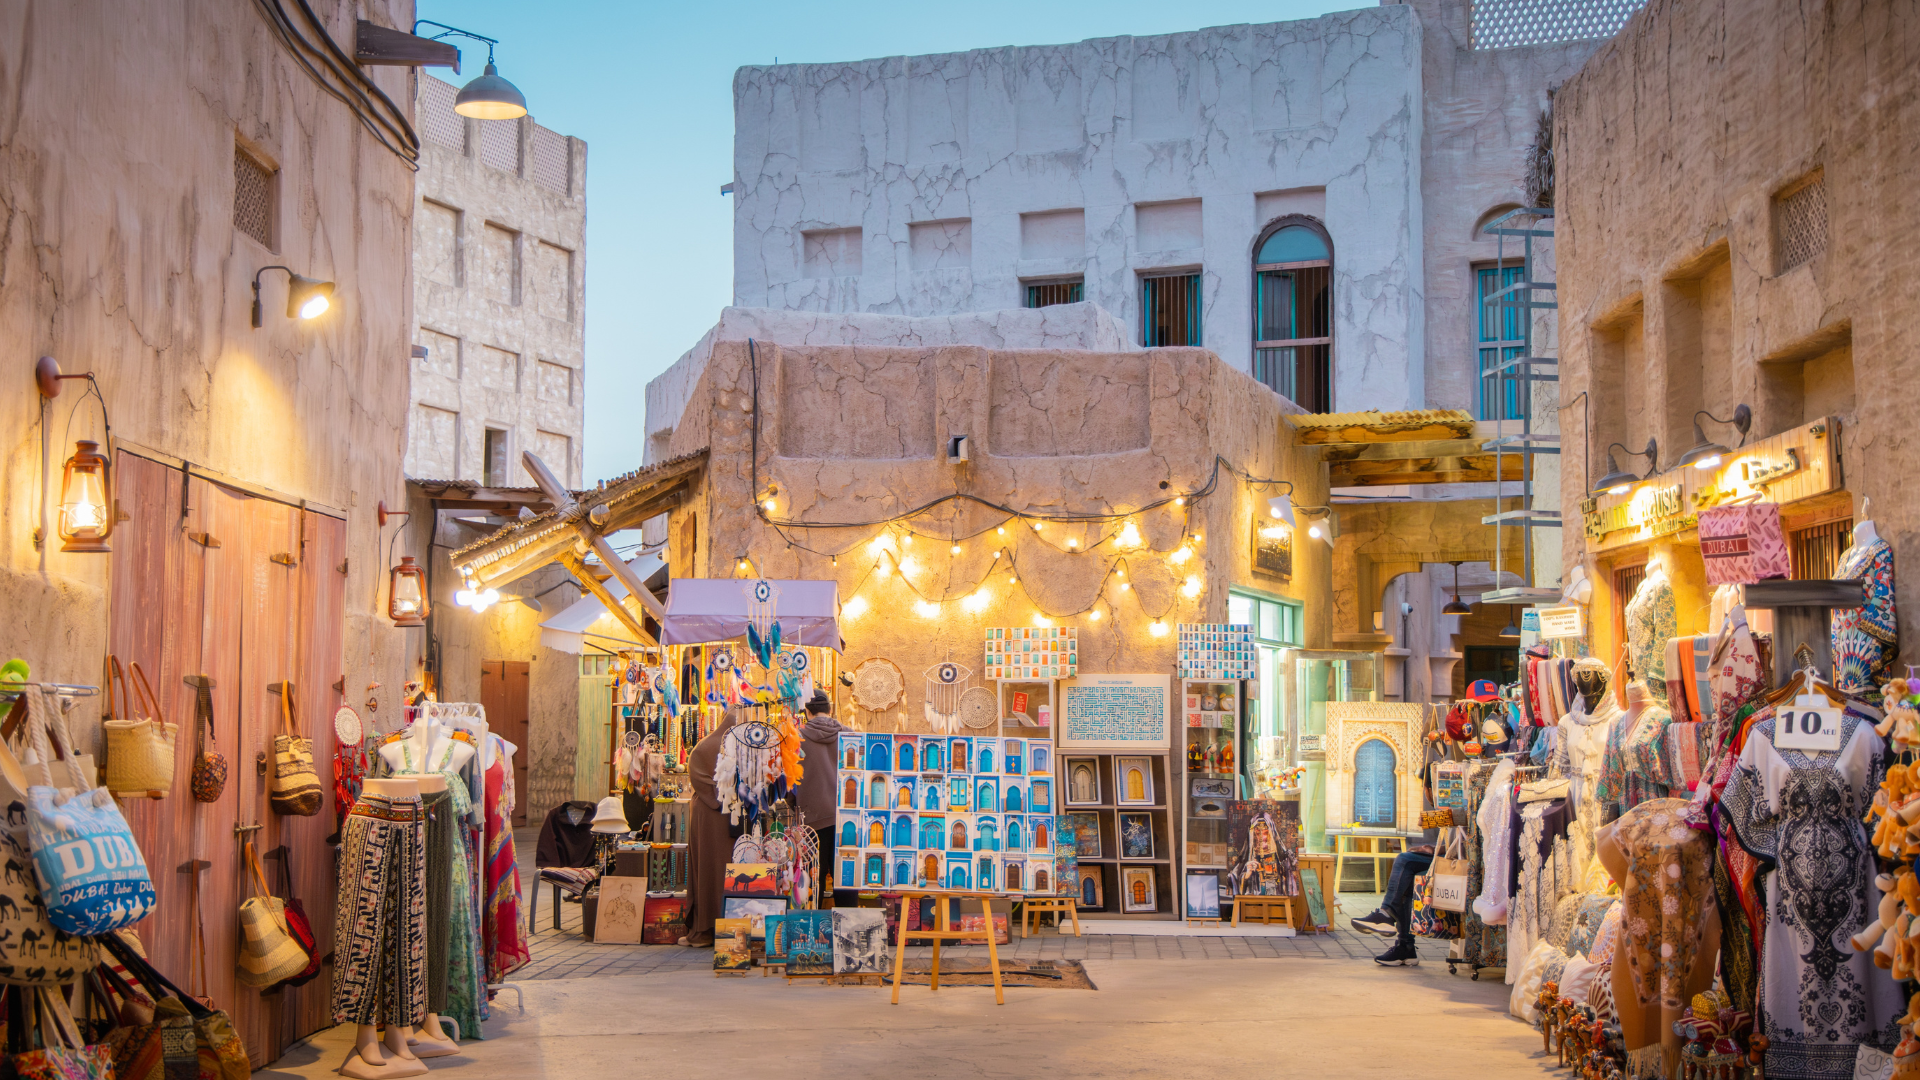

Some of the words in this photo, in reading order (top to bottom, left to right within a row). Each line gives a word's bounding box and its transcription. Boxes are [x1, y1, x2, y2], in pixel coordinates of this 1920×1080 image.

[1707, 539, 1739, 553] DUBAI
[1781, 711, 1822, 735] 10
[61, 882, 109, 906] DUBAI
[1436, 887, 1459, 900] DUBAI
